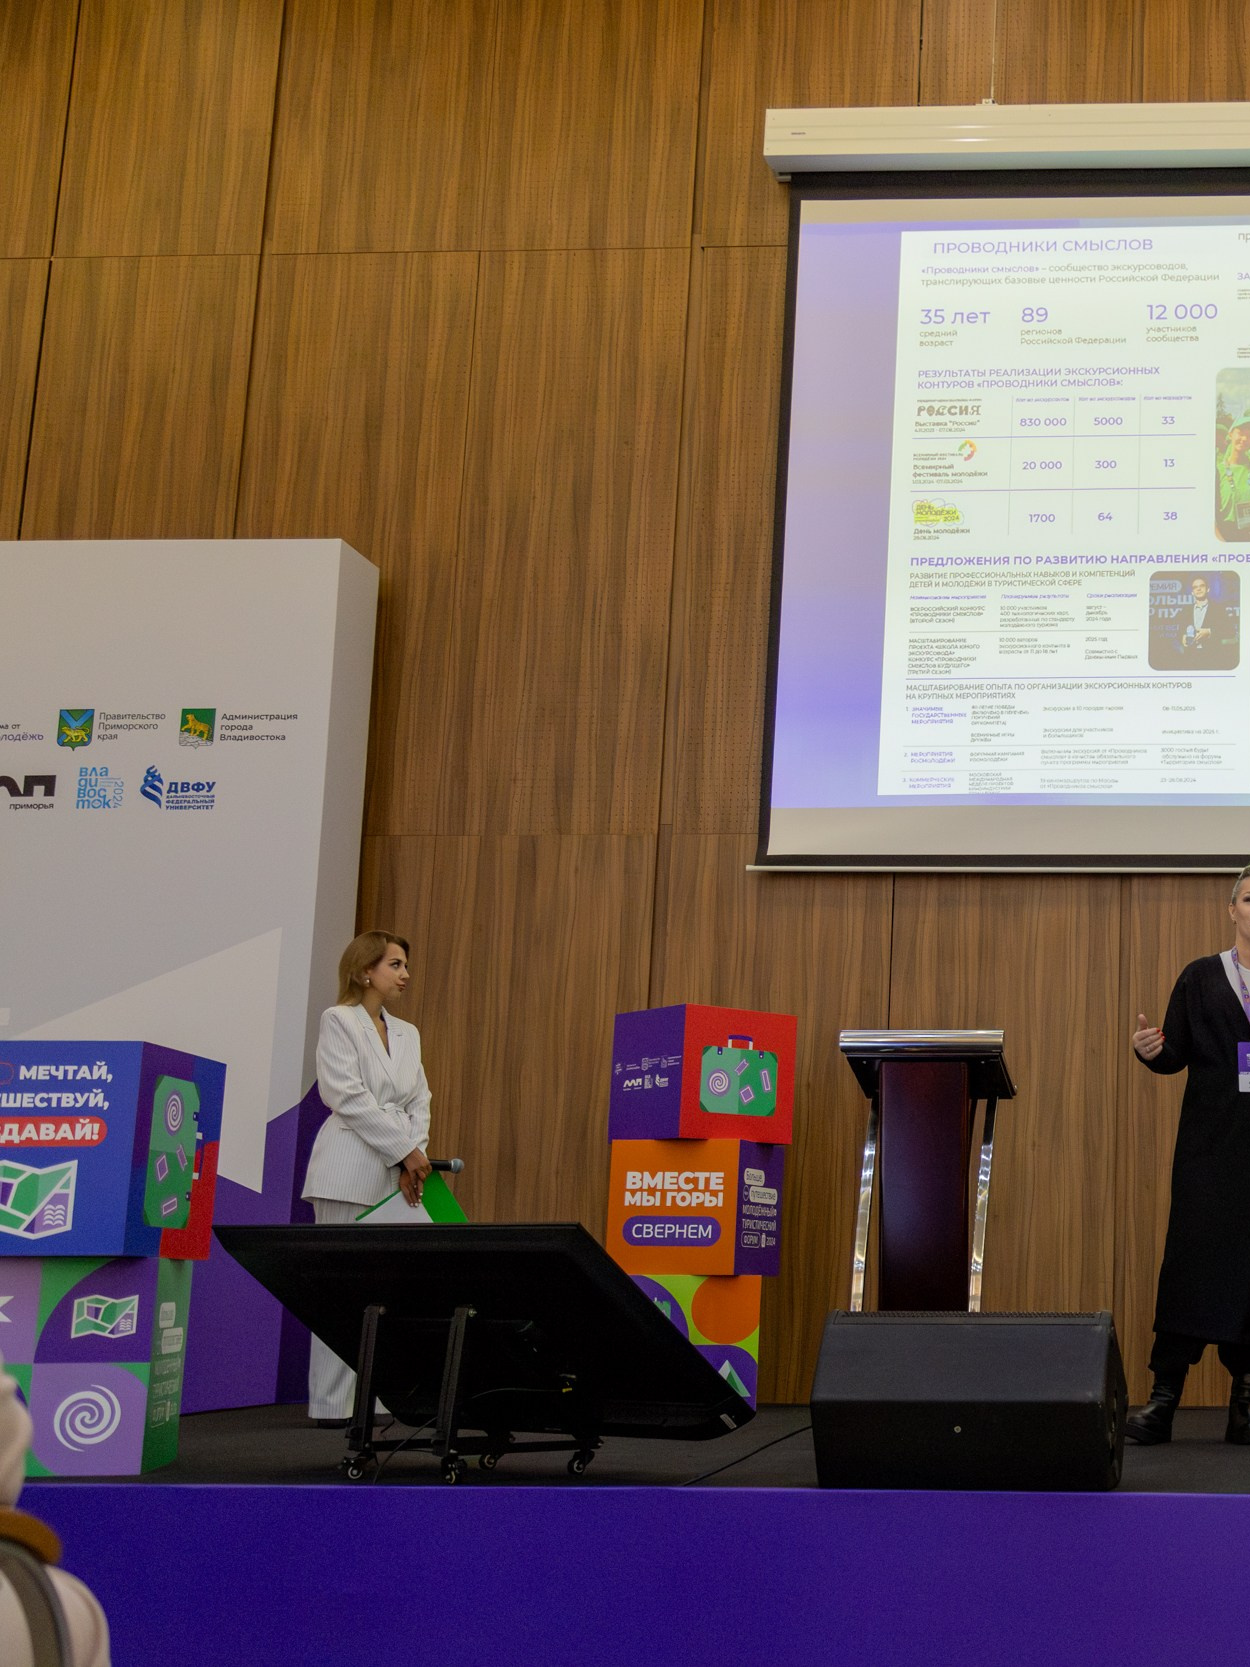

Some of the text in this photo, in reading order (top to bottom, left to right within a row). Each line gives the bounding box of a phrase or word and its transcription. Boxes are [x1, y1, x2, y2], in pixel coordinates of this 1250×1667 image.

[933, 238, 1153, 255] ПРОВОДНИКИ СМЫСЛОВ
[921, 265, 990, 276] «Проводники
[1050, 262, 1108, 272] сообщество
[1112, 263, 1188, 272] экскурсоводов,
[920, 277, 1004, 287] транслирующих
[1005, 275, 1048, 284] базовые
[1099, 274, 1157, 282] Российской
[1161, 272, 1219, 283] Федерации
[920, 308, 990, 324] 35 лет
[1021, 306, 1048, 322] 89
[1146, 303, 1217, 320] 12 000
[919, 329, 957, 338] средний
[1145, 326, 1197, 334] участников
[1020, 336, 1126, 344] Российской Федерации
[1145, 333, 1199, 342] сообщества
[918, 366, 1160, 378] РЕЗУЛЬТАТЫ РЕАЛИЗАЦИИ ЭКСКУРСИОННЫХ
[917, 378, 1123, 389] КОНТУРОВ «ПРОВОДНИКИ СМЫСЛОВ»:
[916, 404, 981, 416] РОССИЯ
[1019, 417, 1066, 426] 830 000
[1093, 416, 1123, 425] 5000
[1161, 416, 1175, 424] 33
[1021, 460, 1062, 470] 20 000
[1094, 460, 1116, 468] 300
[1163, 458, 1174, 467] 13
[1028, 513, 1055, 522] 1700
[1097, 512, 1112, 521] 64
[1163, 511, 1177, 520] 38
[910, 556, 1009, 567] ПРЕДЛОЖЕНИЯ
[1036, 555, 1107, 564] РАЗВИТИЮ
[1111, 554, 1207, 563] НАПРАВЛЕНИЯ
[1034, 570, 1071, 579] НАВЫКОВ
[1079, 569, 1135, 577] КОМПЕТЕНЦИЙ
[908, 580, 933, 588] ДЕТЕЙ
[99, 712, 166, 721] Правительство
[98, 722, 158, 731] Приморского
[0, 732, 44, 742] лодёжь
[167, 782, 216, 794] ДВФУ
[19, 1061, 113, 1083] МЕЧТАЙ,
[0, 1089, 109, 1110] ШЕСТВУЙ,
[0, 1119, 100, 1143] ДАВАЙ!
[626, 1171, 724, 1190] ВМЕСТЕ
[624, 1191, 723, 1207] МЫ ГОРЫ
[632, 1224, 712, 1238] СВЕРНЕМ
